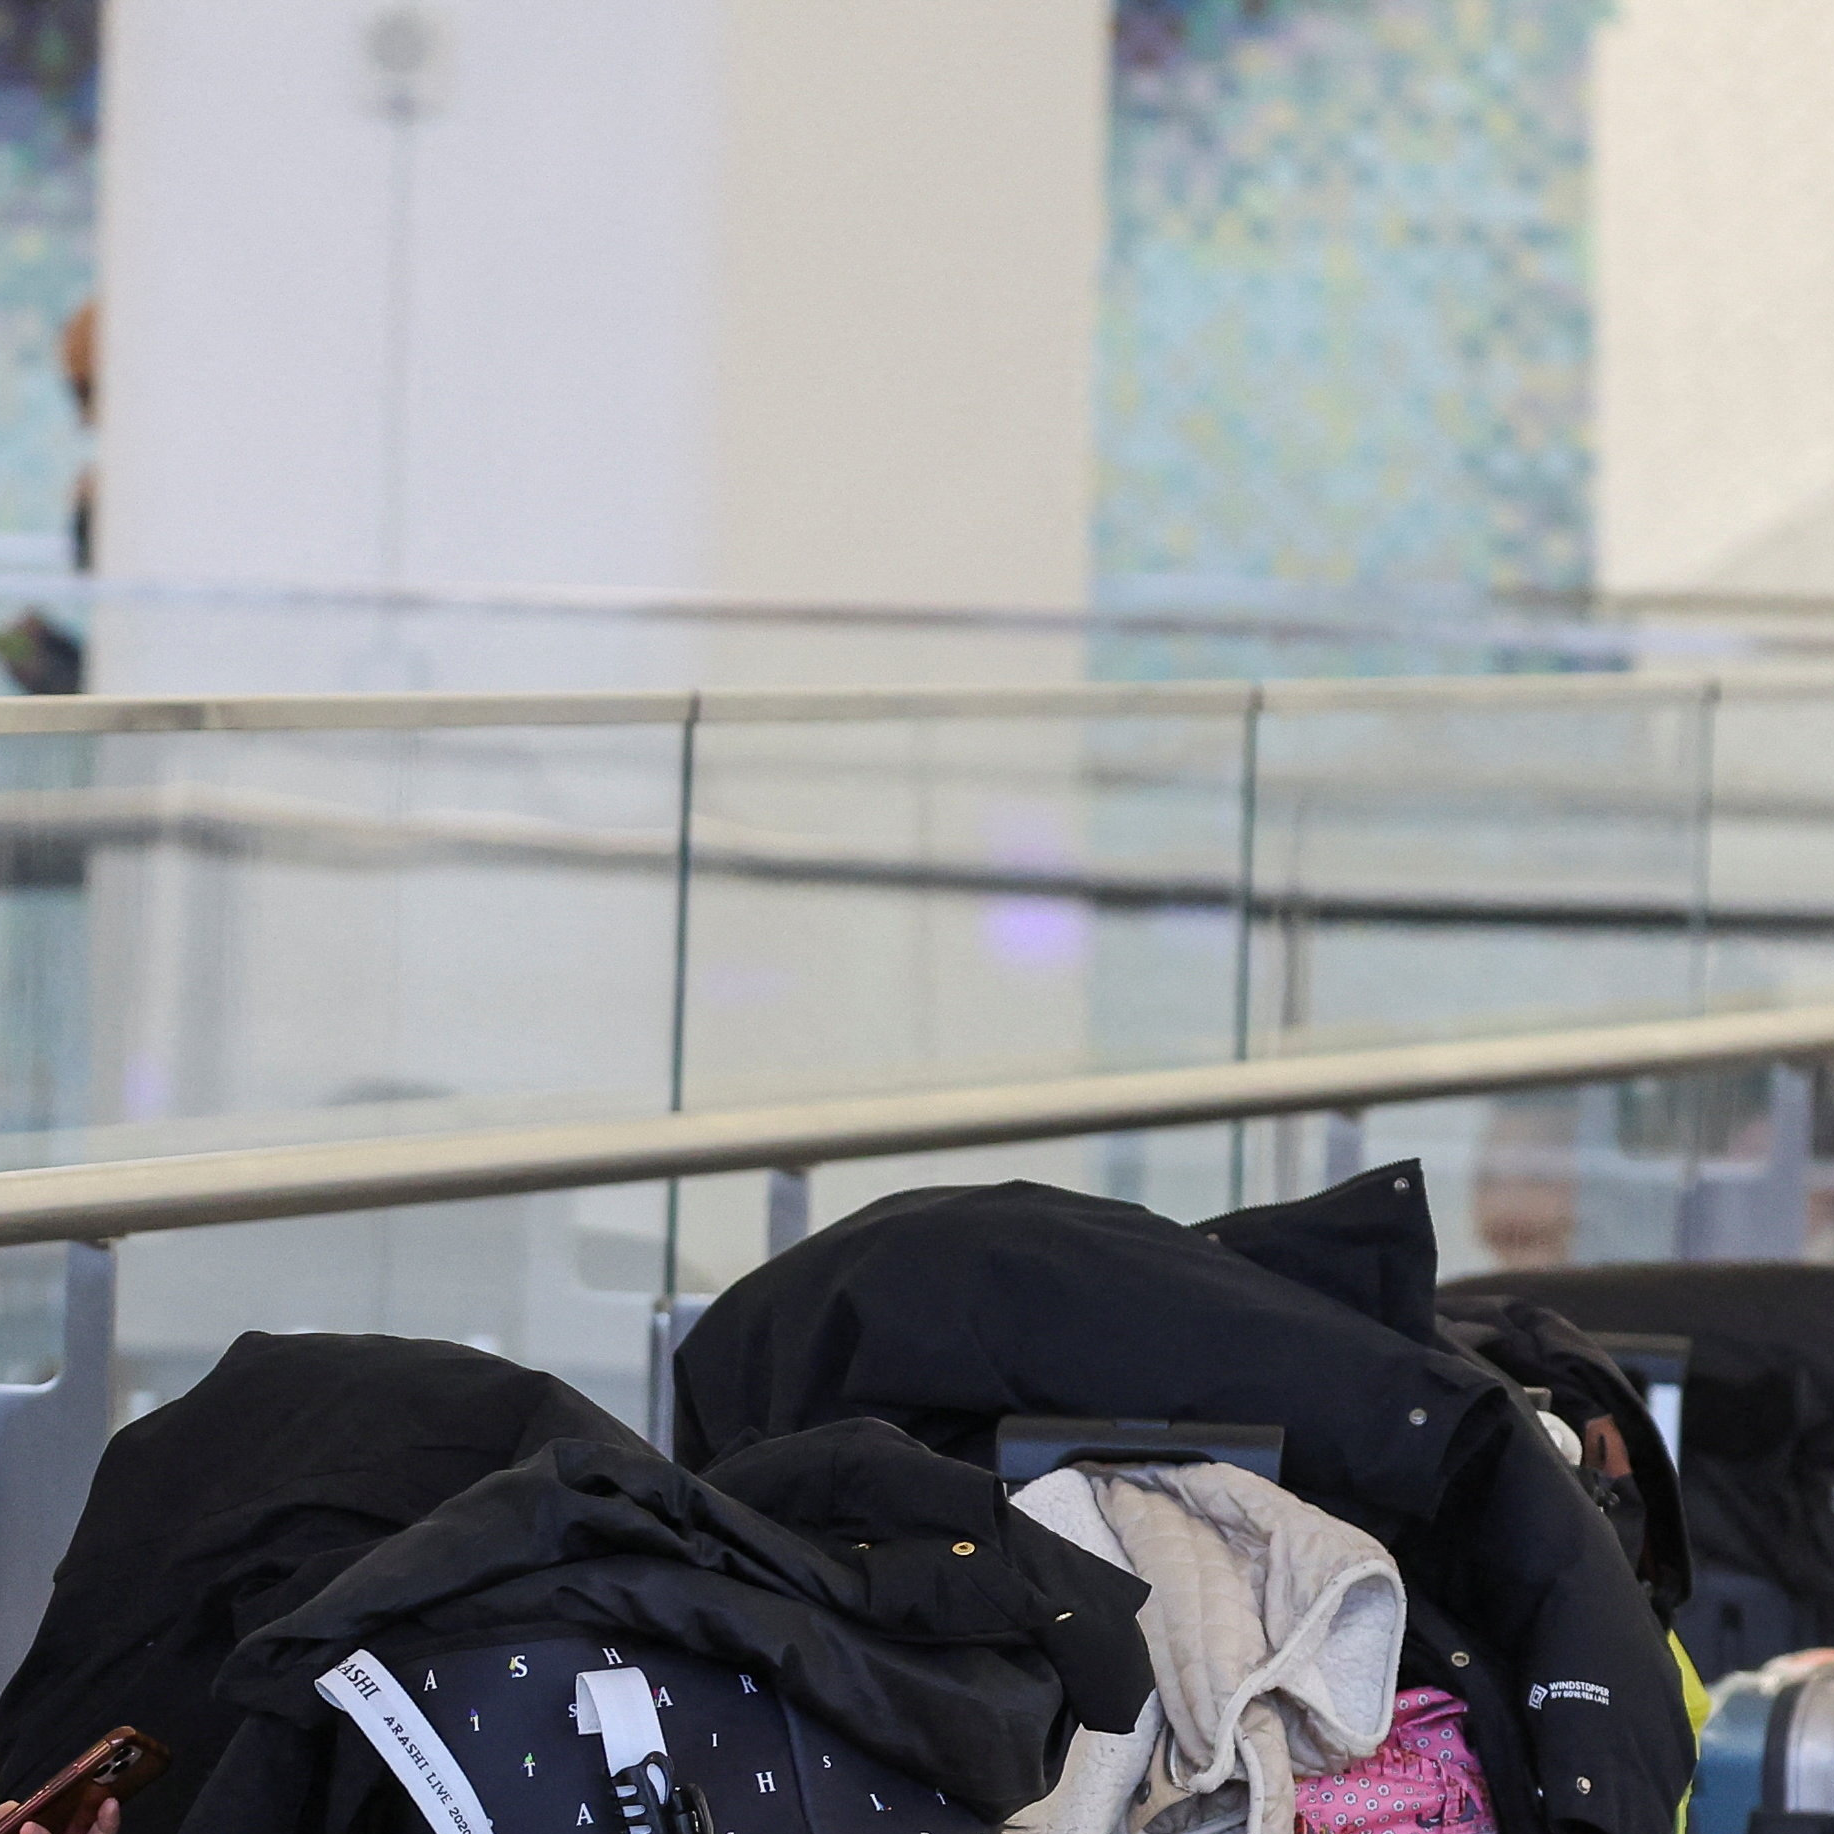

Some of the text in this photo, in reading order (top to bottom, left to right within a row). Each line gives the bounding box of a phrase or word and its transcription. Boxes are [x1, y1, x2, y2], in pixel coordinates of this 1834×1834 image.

[602, 1648, 623, 1665] H
[423, 1669, 438, 1692] A
[739, 1674, 758, 1694] R
[1549, 1681, 1609, 1697] WINDSTOPPER
[656, 1686, 674, 1708] A
[383, 1716, 429, 1771] ARASHI
[426, 1772, 453, 1805] LIVE
[822, 1755, 832, 1769] S
[755, 1771, 777, 1794] H
[577, 1803, 594, 1826] A
